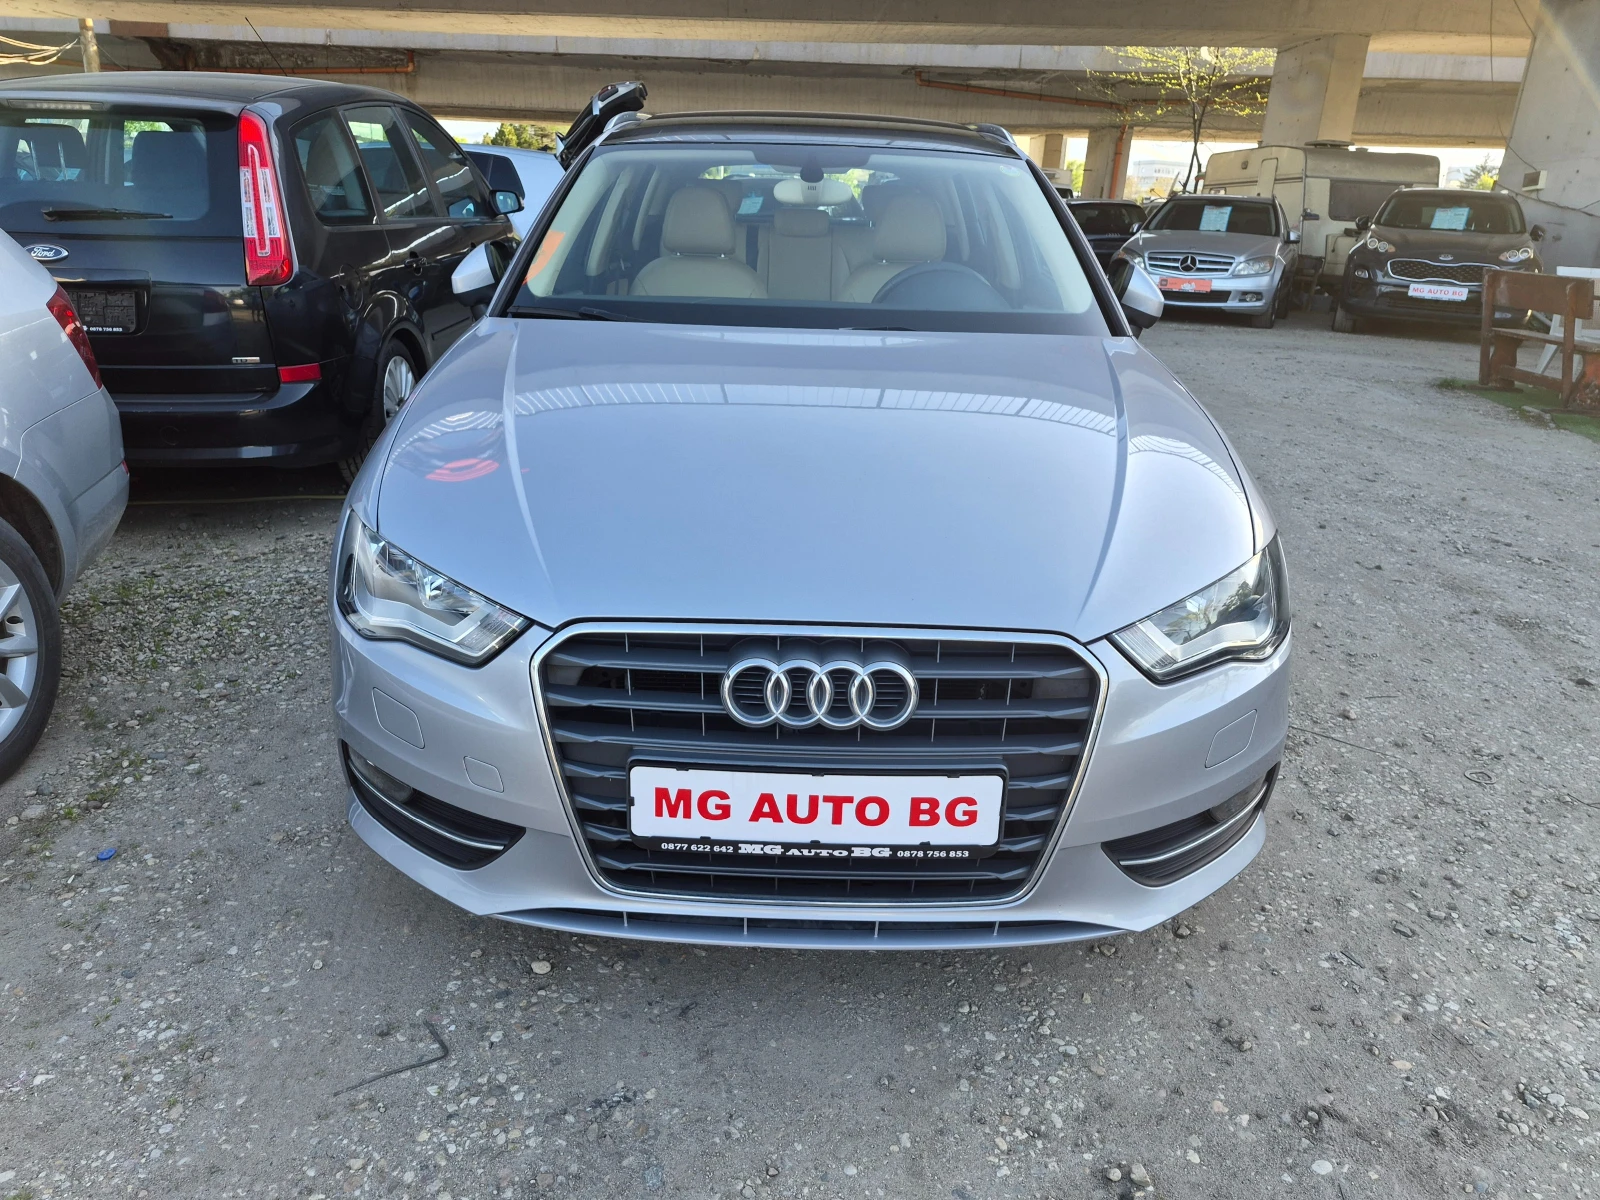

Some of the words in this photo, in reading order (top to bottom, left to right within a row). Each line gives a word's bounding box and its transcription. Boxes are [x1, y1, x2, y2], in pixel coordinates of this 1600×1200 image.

[31, 246, 56, 257] Ford
[1427, 288, 1450, 296] AUTO
[654, 786, 732, 821] MG
[748, 792, 890, 827] AUTO
[908, 796, 978, 827] BG
[661, 842, 688, 851] 0877
[690, 843, 711, 852] 622
[713, 844, 734, 853] 642
[738, 843, 784, 855] MG
[786, 849, 849, 857] AUTO
[850, 847, 893, 858] BG
[897, 850, 924, 858] 0878
[926, 850, 947, 858] 756
[949, 850, 969, 858] 853
